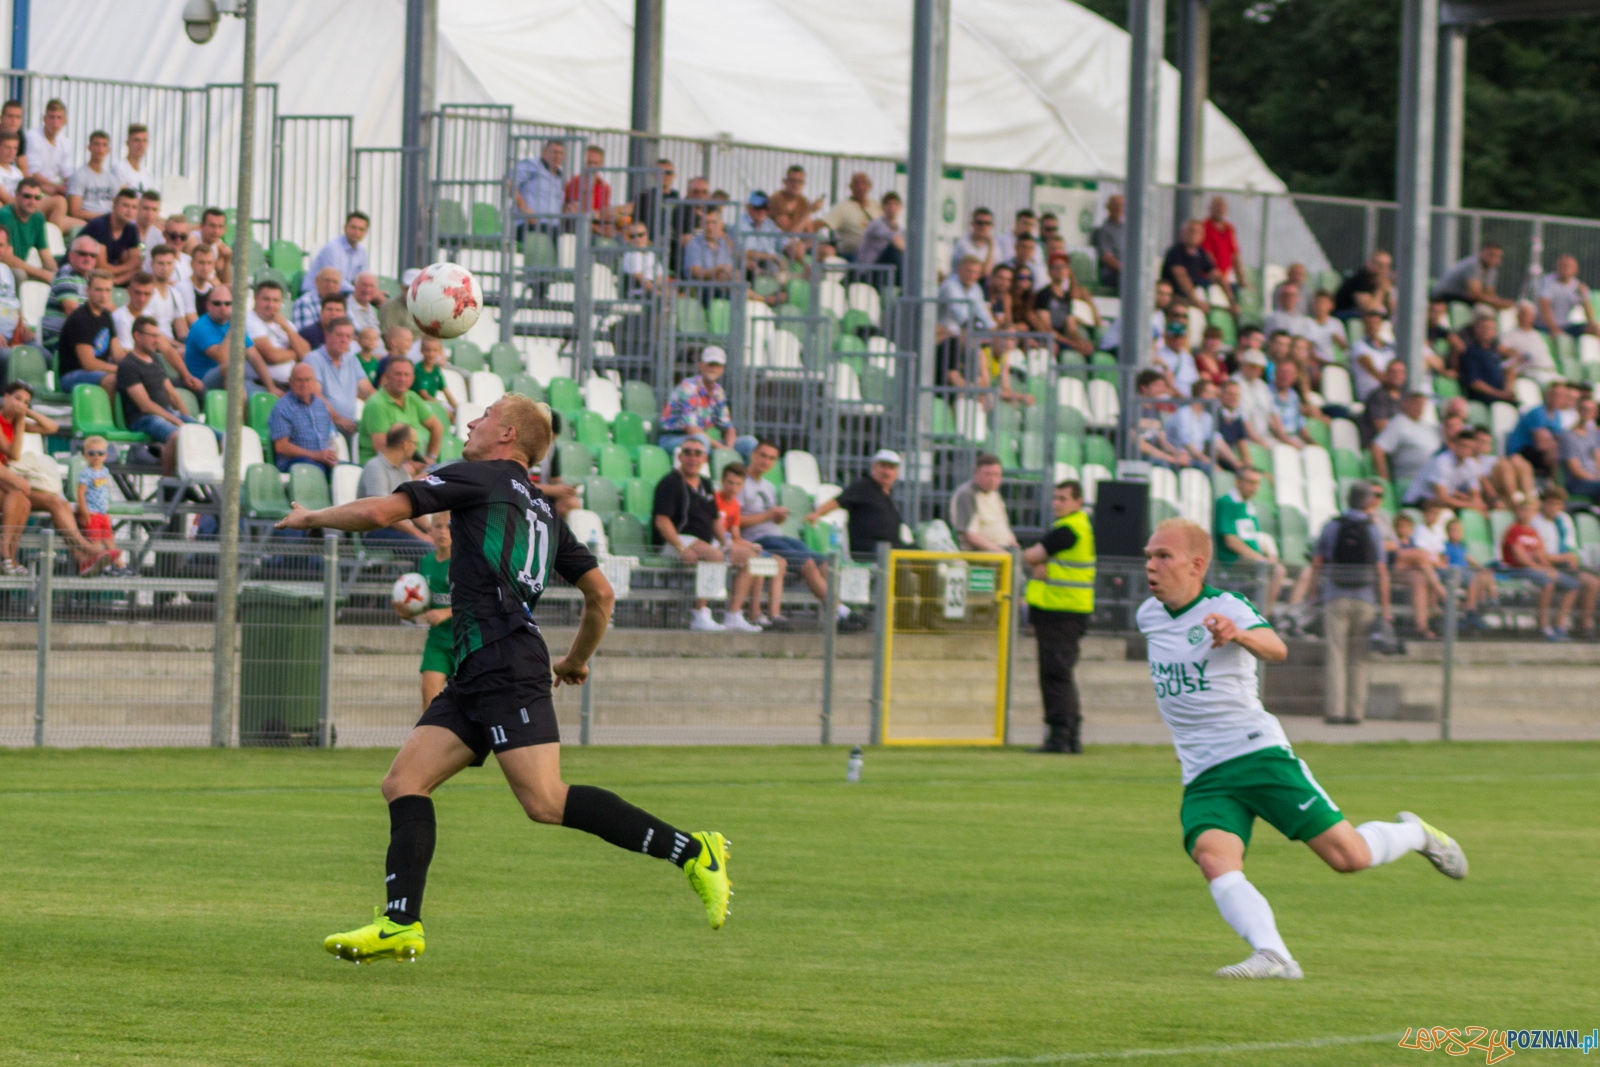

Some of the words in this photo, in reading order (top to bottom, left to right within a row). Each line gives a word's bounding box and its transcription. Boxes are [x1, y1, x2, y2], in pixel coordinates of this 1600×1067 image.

[517, 508, 549, 594] 11
[1151, 659, 1209, 681] AMILY
[1155, 677, 1211, 698] OUSE
[491, 725, 508, 745] 11
